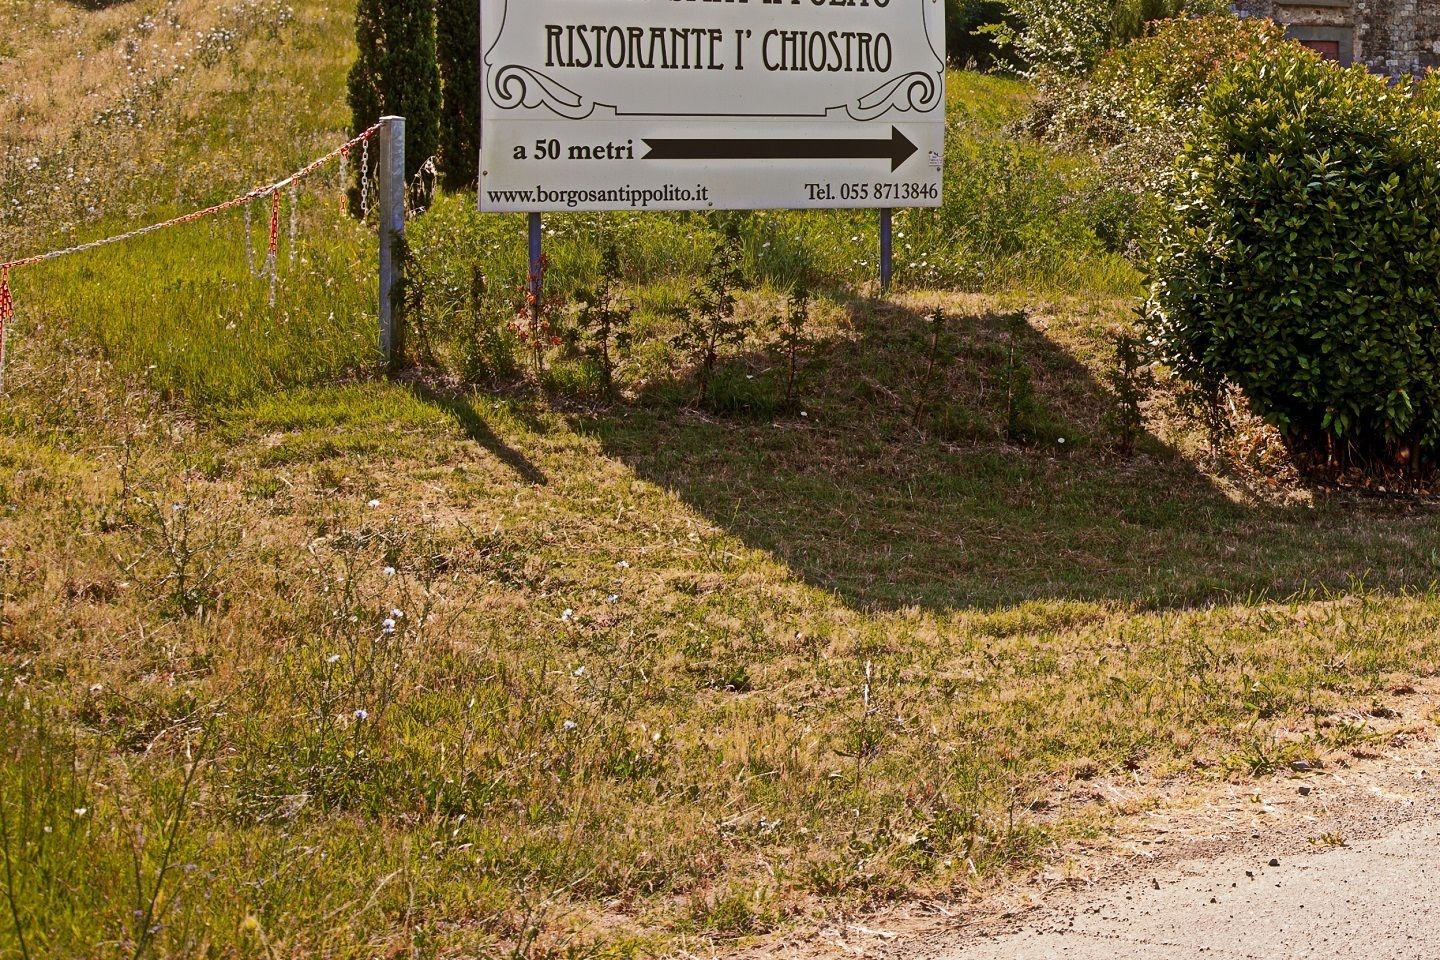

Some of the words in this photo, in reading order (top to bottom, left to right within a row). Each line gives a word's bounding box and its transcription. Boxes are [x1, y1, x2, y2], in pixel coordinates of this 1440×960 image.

[544, 24, 725, 71] RISTORANTE
[762, 28, 893, 73] CHIOSTRO
[513, 145, 528, 160] a
[534, 138, 561, 160] 50
[567, 138, 634, 160] metri
[487, 183, 709, 208] www.borgosantippolito.it
[804, 183, 836, 200] Tel.
[840, 182, 869, 200] 055
[873, 182, 938, 200] 8713846
